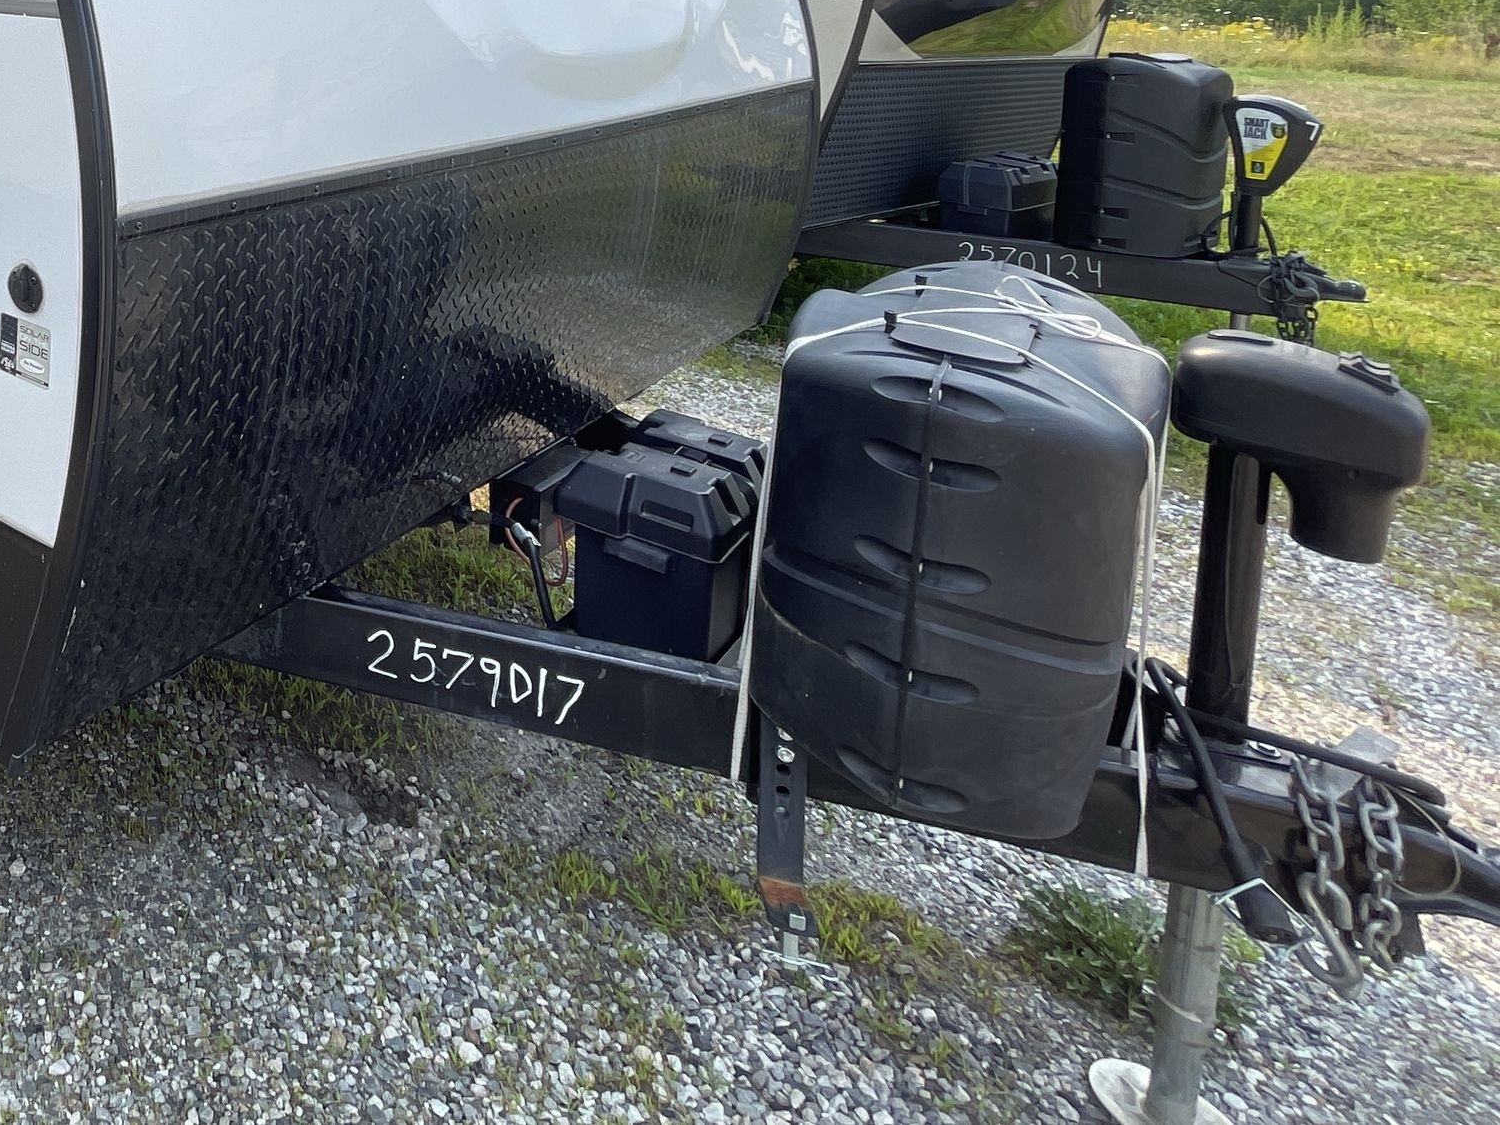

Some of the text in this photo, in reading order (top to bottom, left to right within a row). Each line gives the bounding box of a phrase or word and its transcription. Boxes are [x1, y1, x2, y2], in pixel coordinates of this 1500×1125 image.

[1243, 117, 1270, 127] SMART
[1243, 125, 1268, 140] JACK
[958, 241, 1102, 289] 2570124
[19, 325, 50, 342] SOLAR
[19, 339, 49, 361] SIDE
